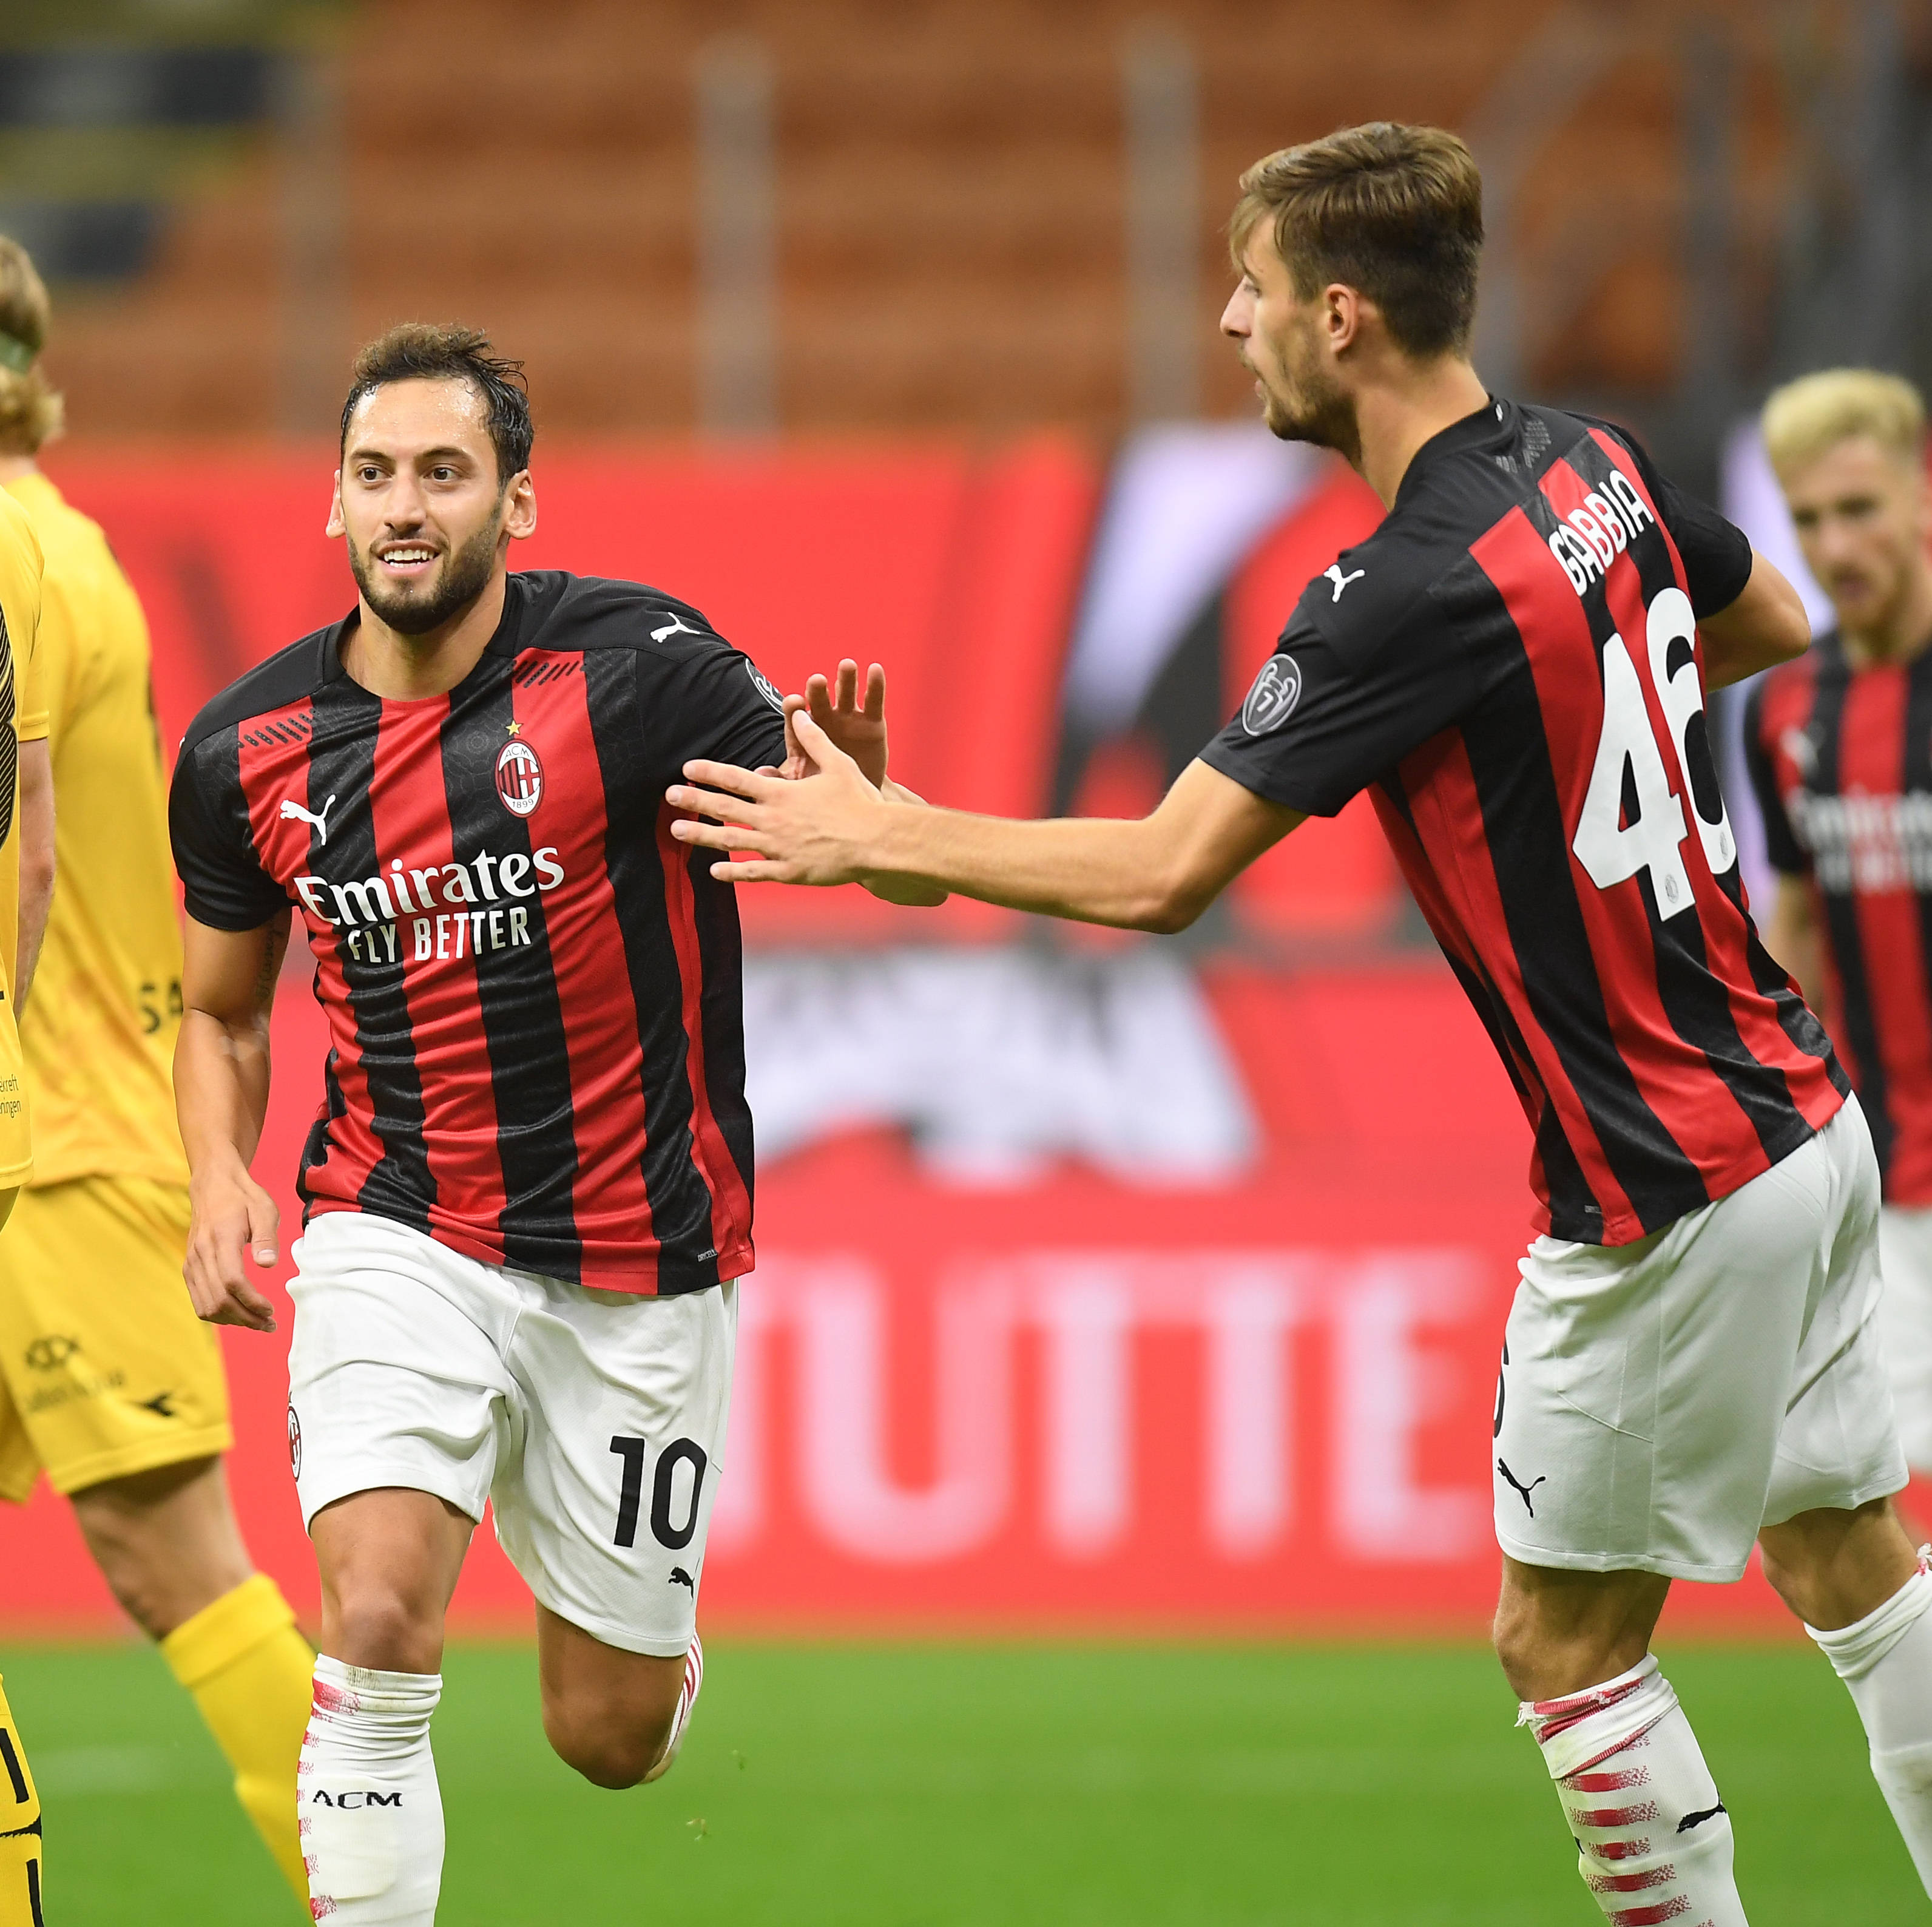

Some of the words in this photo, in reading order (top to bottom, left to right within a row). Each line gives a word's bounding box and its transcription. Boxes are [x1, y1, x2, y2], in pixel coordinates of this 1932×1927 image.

[1549, 470, 1655, 597] GABBIA
[1257, 691, 1274, 713] 7
[504, 745, 529, 760] ACM
[1573, 587, 1737, 922] 46
[512, 798, 534, 808] 1899
[294, 847, 564, 926] Emirates
[347, 923, 397, 964] FLY
[414, 906, 531, 961] BETTER
[609, 1435, 708, 1550] 10
[312, 1790, 403, 1809] ACM
